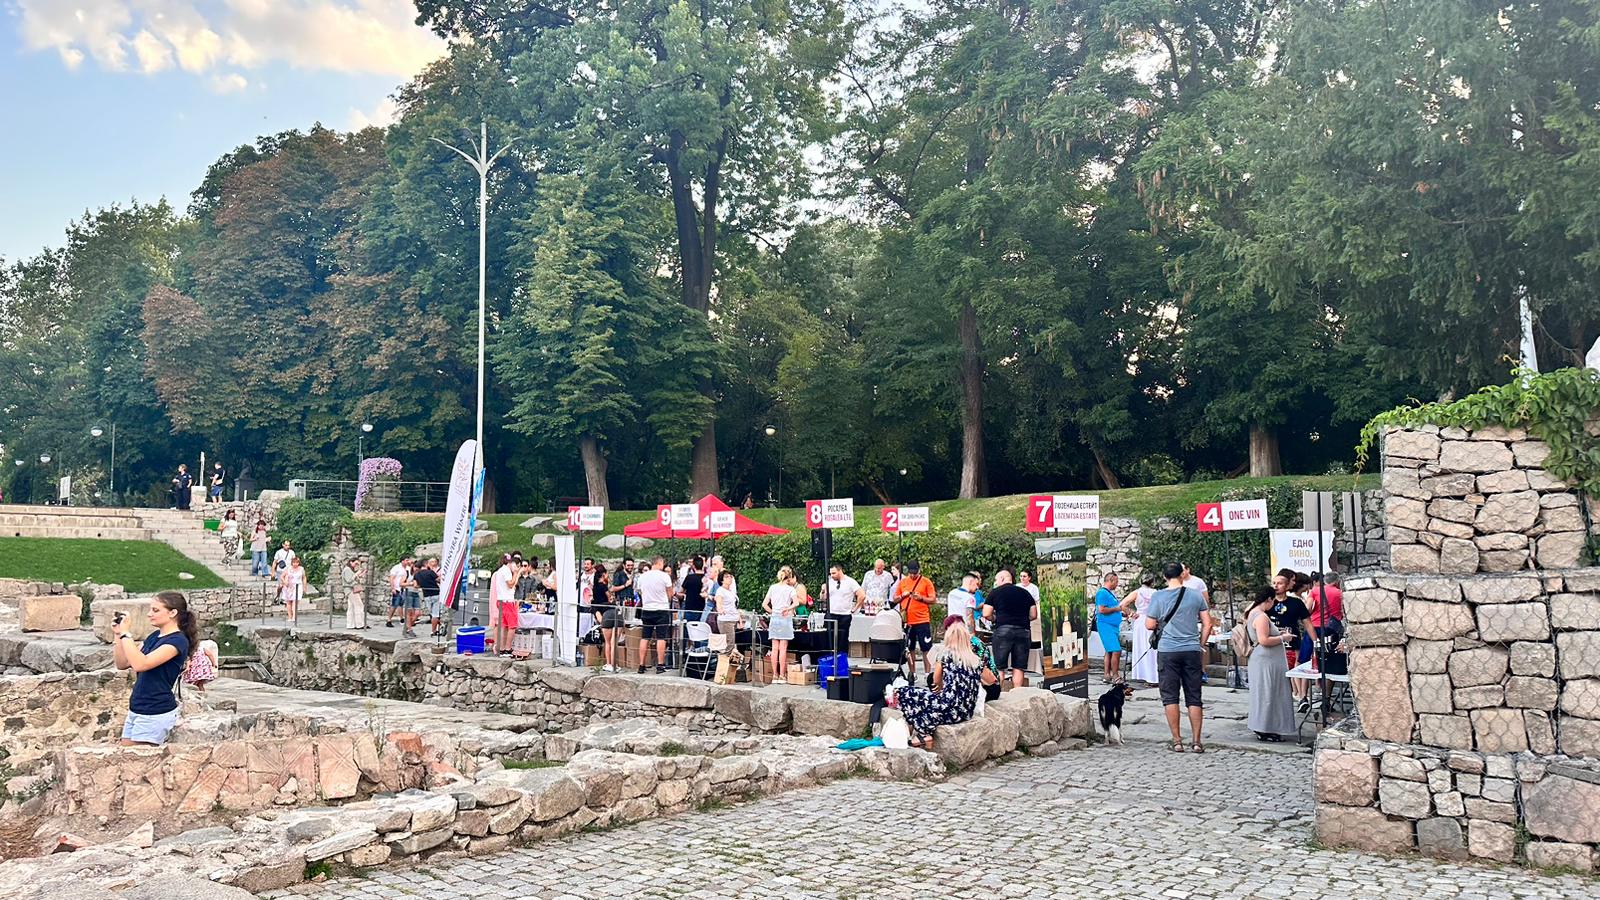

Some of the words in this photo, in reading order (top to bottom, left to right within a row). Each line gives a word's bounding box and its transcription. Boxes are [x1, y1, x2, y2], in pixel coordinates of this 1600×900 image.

[661, 509, 671, 526] 9
[810, 504, 822, 524] 8
[886, 511, 897, 528] 2
[1036, 501, 1051, 522] 7
[1203, 507, 1220, 526] 4
[1228, 510, 1245, 521] ONE
[1245, 509, 1260, 519] VIN
[1292, 539, 1314, 548] ЕДНО
[1052, 551, 1072, 561] ANGUS
[1288, 549, 1312, 559] ВИНО,
